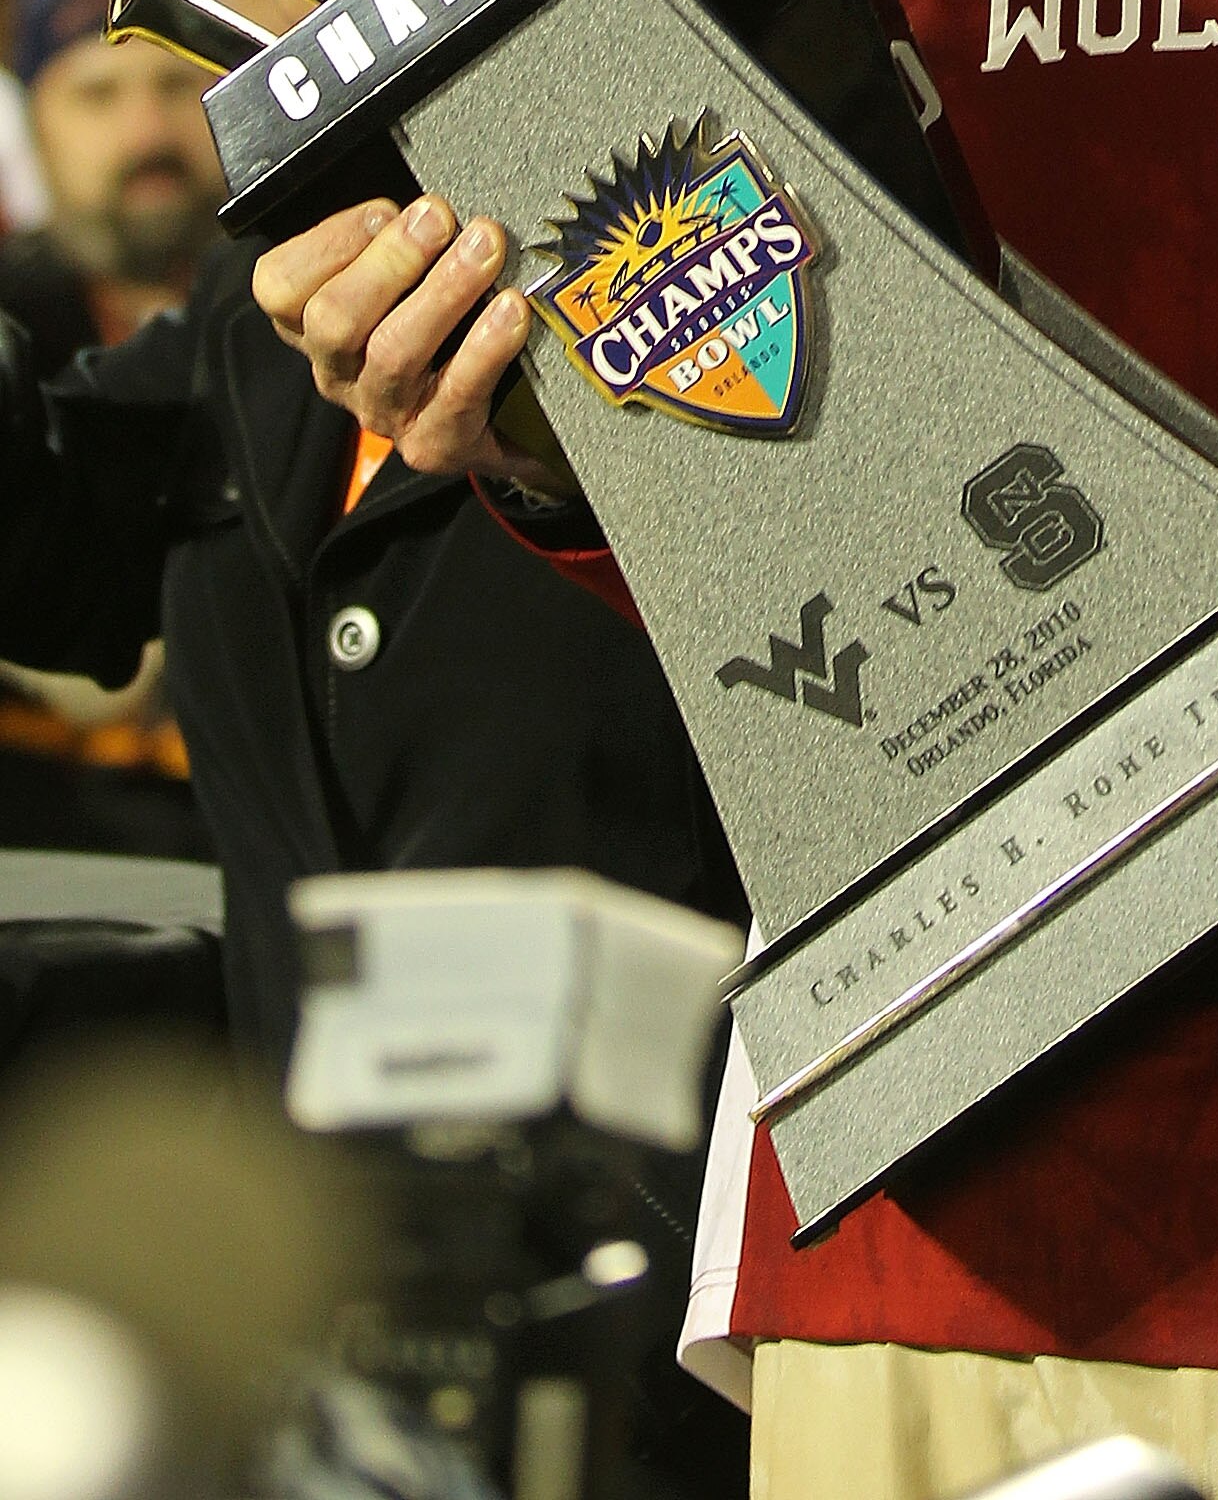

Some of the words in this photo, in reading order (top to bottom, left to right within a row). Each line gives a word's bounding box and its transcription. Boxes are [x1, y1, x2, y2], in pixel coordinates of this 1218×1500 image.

[591, 206, 802, 386] CHAMPS
[667, 296, 790, 393] BOWL
[881, 674, 988, 760] DECEMBER
[1024, 601, 1081, 651] 2010
[1004, 635, 1092, 704] FLORIDA
[810, 873, 980, 1007] CHARLES
[1000, 835, 1044, 867] H.
[1063, 736, 1165, 819] ROHE
